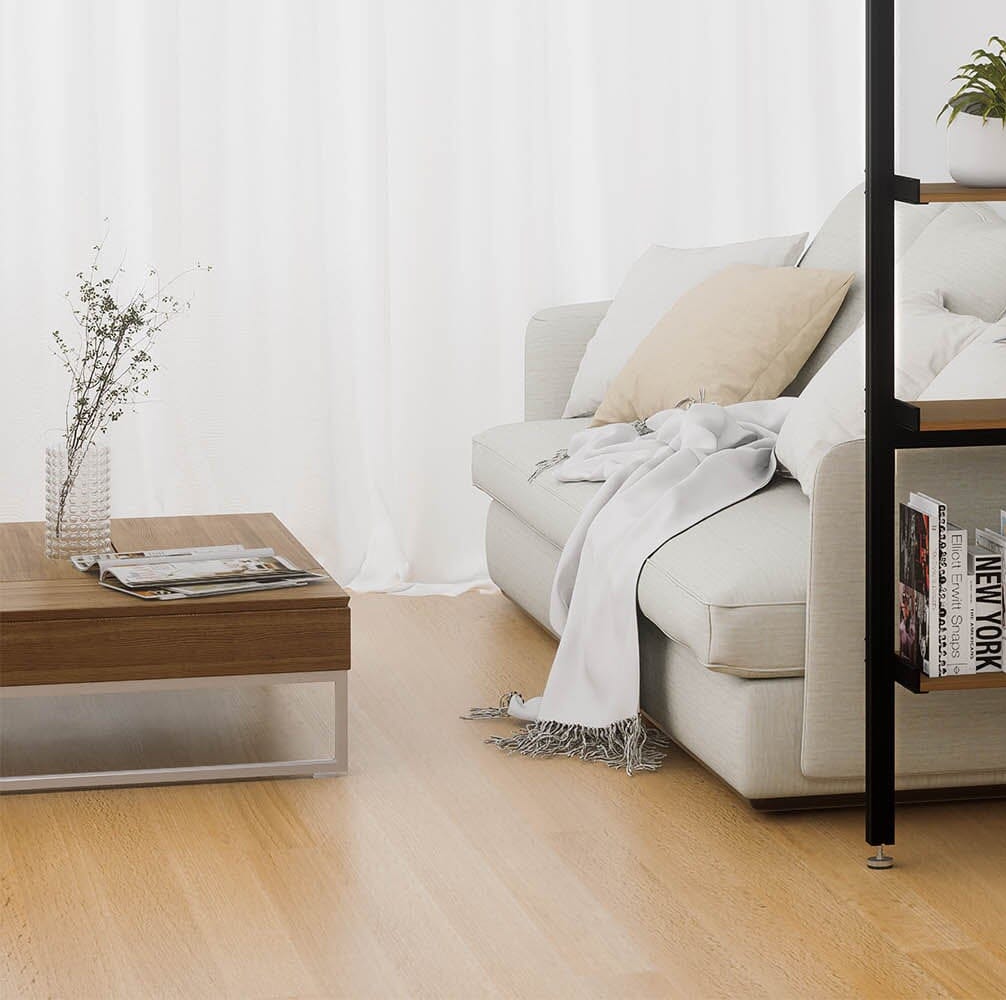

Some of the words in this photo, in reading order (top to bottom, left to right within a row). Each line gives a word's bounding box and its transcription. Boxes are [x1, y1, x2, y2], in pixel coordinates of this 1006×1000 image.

[951, 534, 962, 569] Elliott
[951, 574, 962, 610] Erwitt
[976, 557, 1002, 604] NEW
[947, 615, 962, 659] Snaps
[976, 612, 1002, 671] YORK
